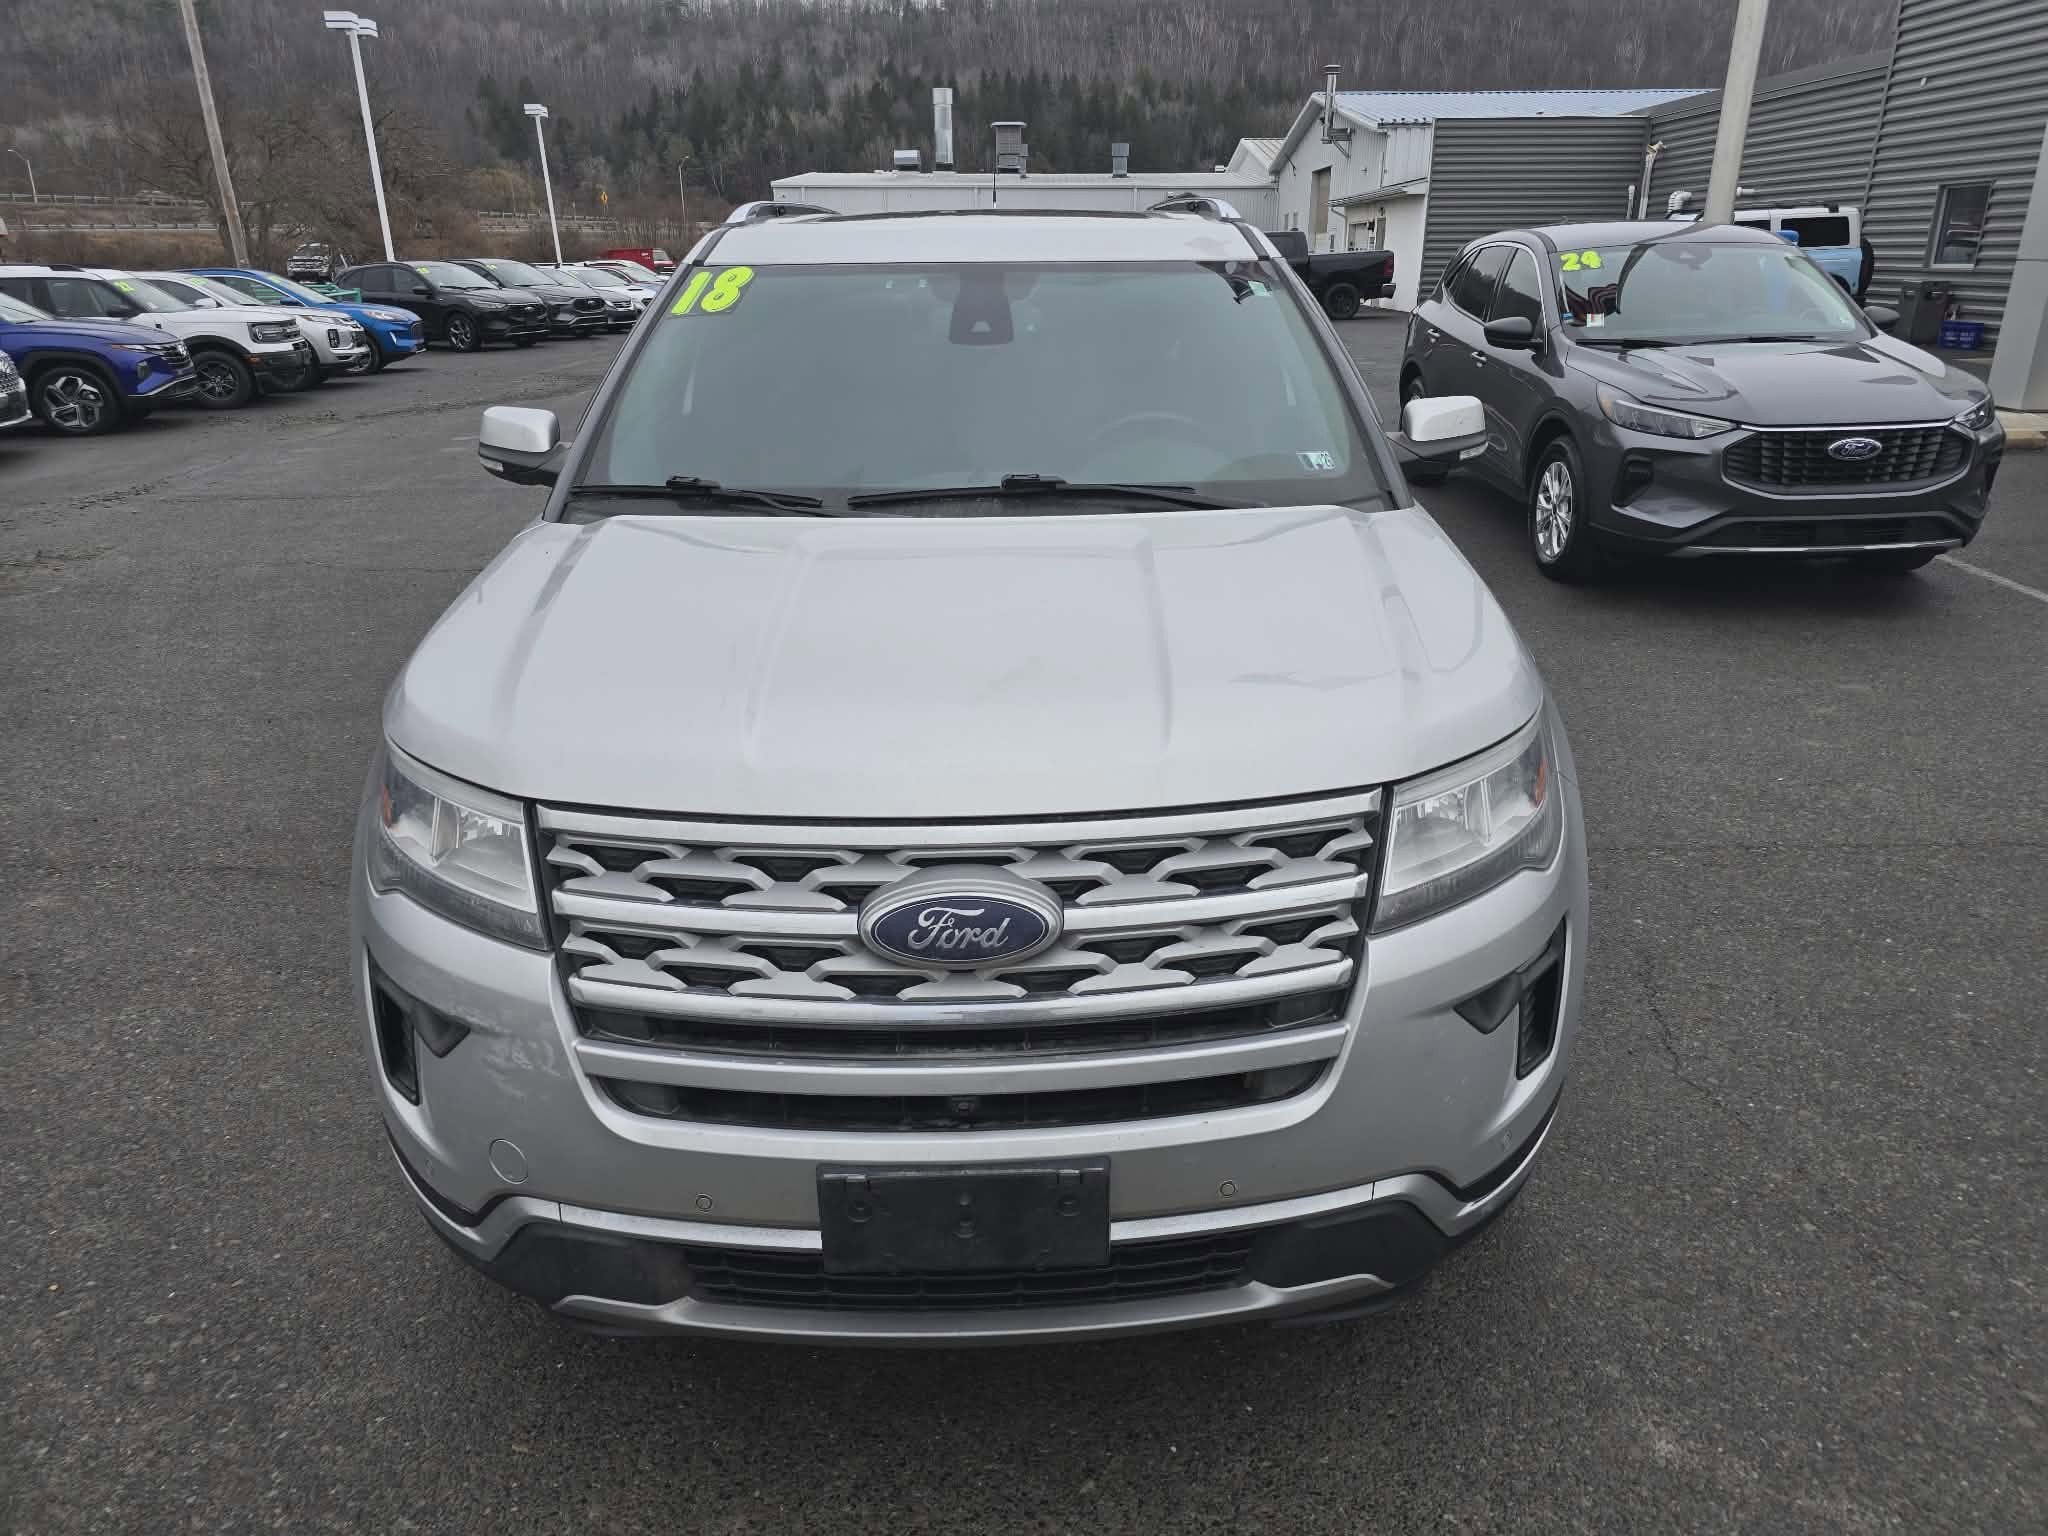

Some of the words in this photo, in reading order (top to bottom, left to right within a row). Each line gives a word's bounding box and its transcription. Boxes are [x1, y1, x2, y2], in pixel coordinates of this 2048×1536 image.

[671, 266, 755, 315] 18
[1840, 442, 1873, 456] Ford
[907, 906, 1010, 950] Ford
